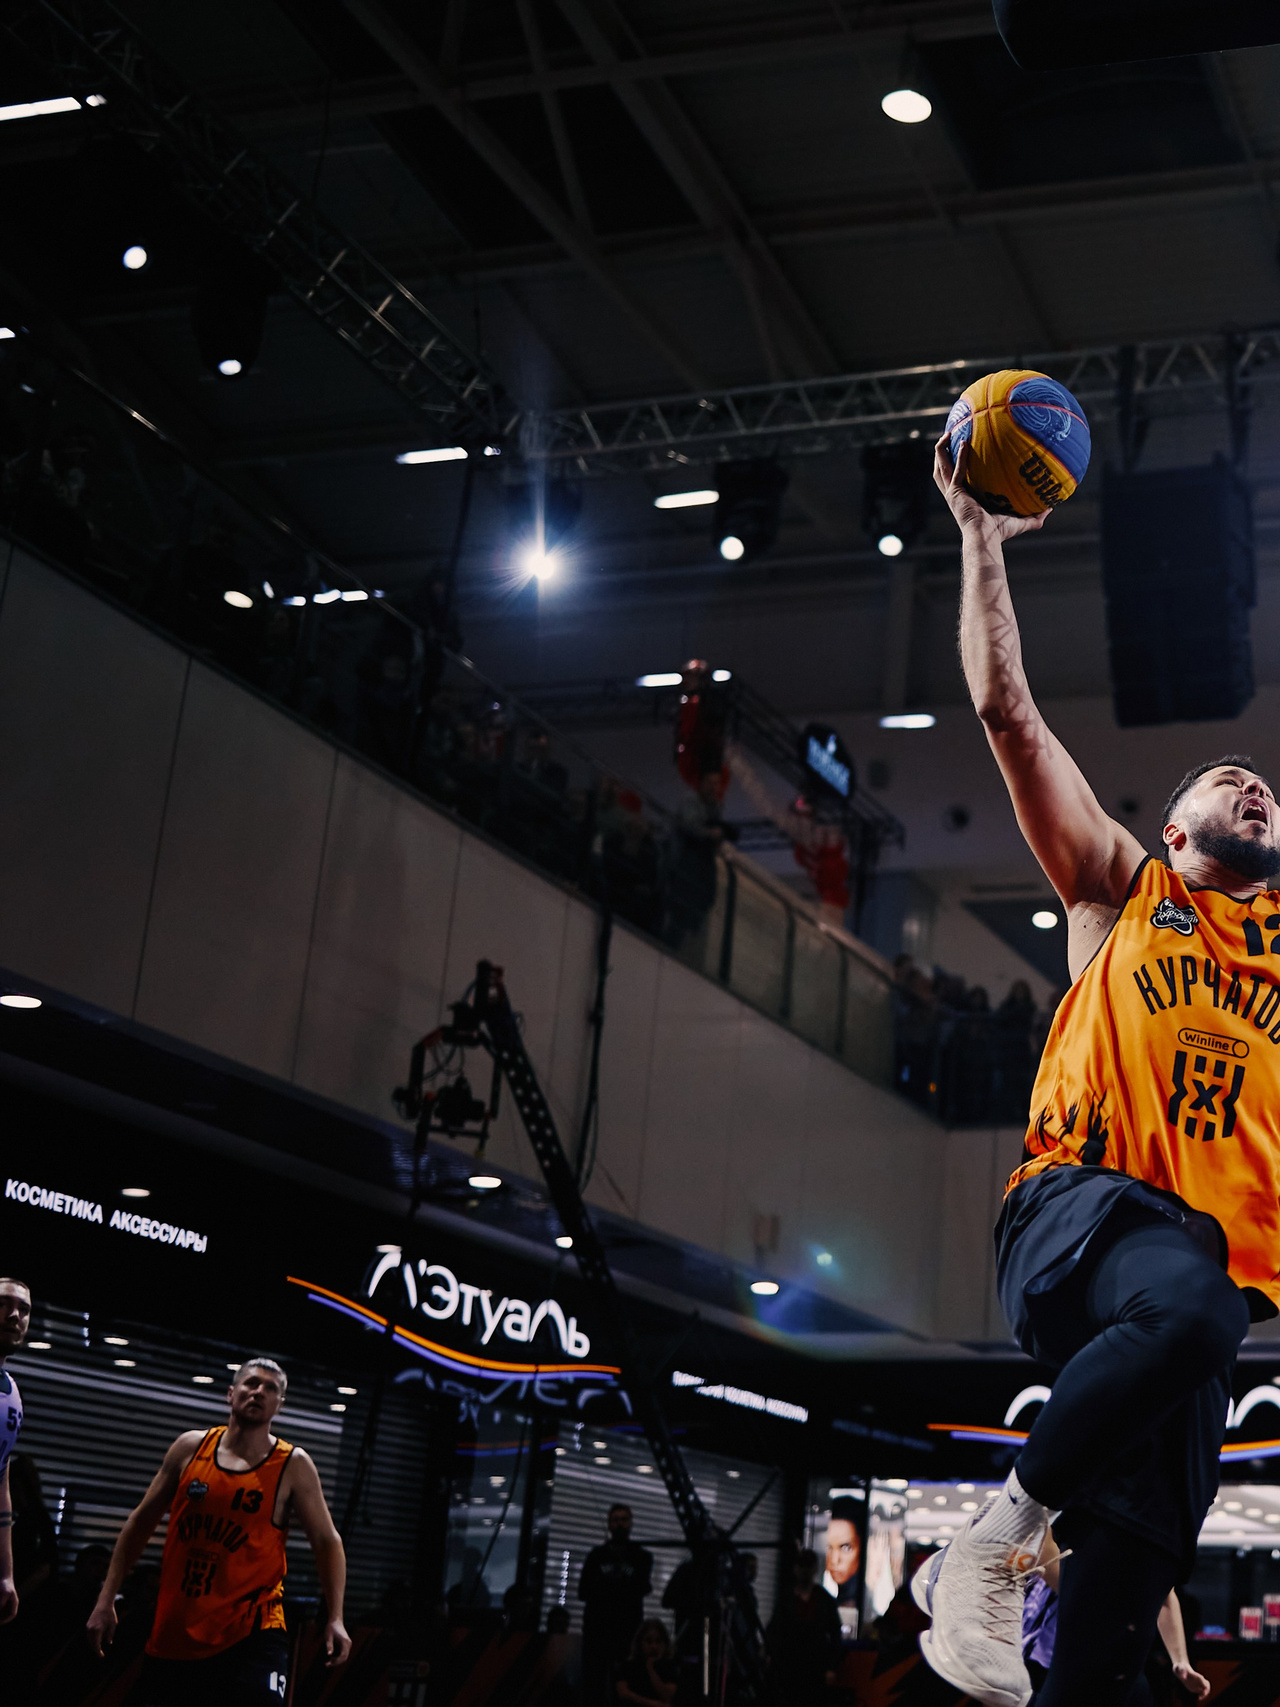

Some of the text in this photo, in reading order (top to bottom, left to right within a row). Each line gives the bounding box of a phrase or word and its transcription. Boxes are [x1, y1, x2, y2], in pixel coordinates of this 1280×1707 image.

[1185, 1032, 1229, 1051] Winline
[5, 1178, 208, 1253] КОСМЕТИКА АКСЕССУАРЫ
[231, 1487, 263, 1513] 13
